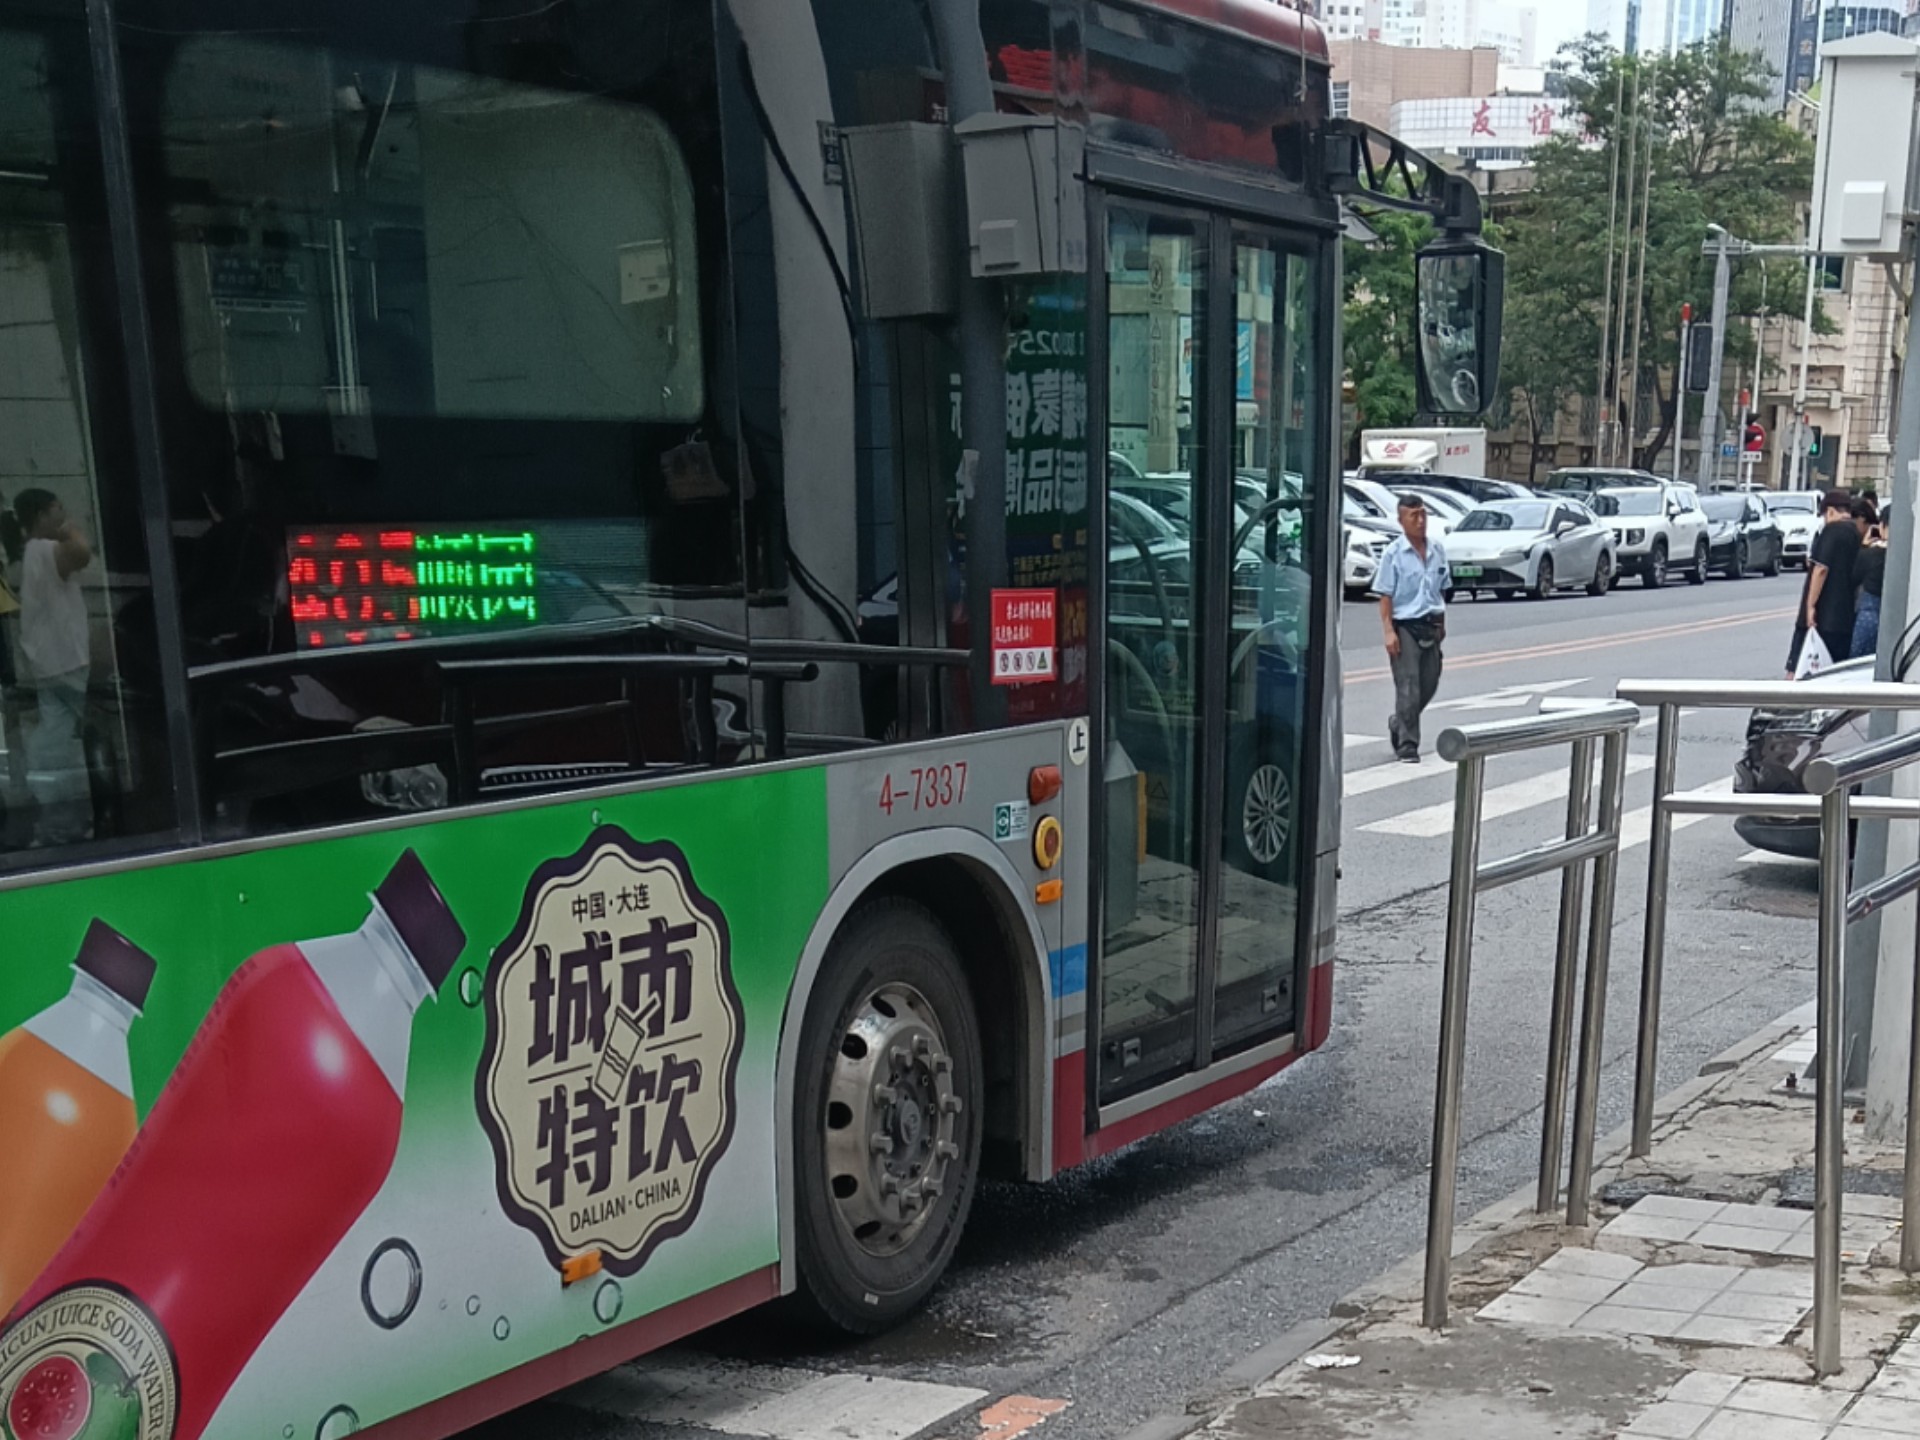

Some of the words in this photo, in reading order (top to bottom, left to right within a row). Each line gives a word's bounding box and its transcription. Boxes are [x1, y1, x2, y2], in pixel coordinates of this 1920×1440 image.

[1072, 725, 1086, 753] 上
[878, 761, 968, 816] 4-7337
[571, 882, 651, 923] 中国·大连
[527, 915, 698, 1069] 城市
[535, 1052, 702, 1210] 特饮
[0, 1312, 48, 1370] ICUN
[47, 1302, 103, 1335] JUICE
[101, 1308, 145, 1361] SODA
[139, 1350, 164, 1434] WATER
